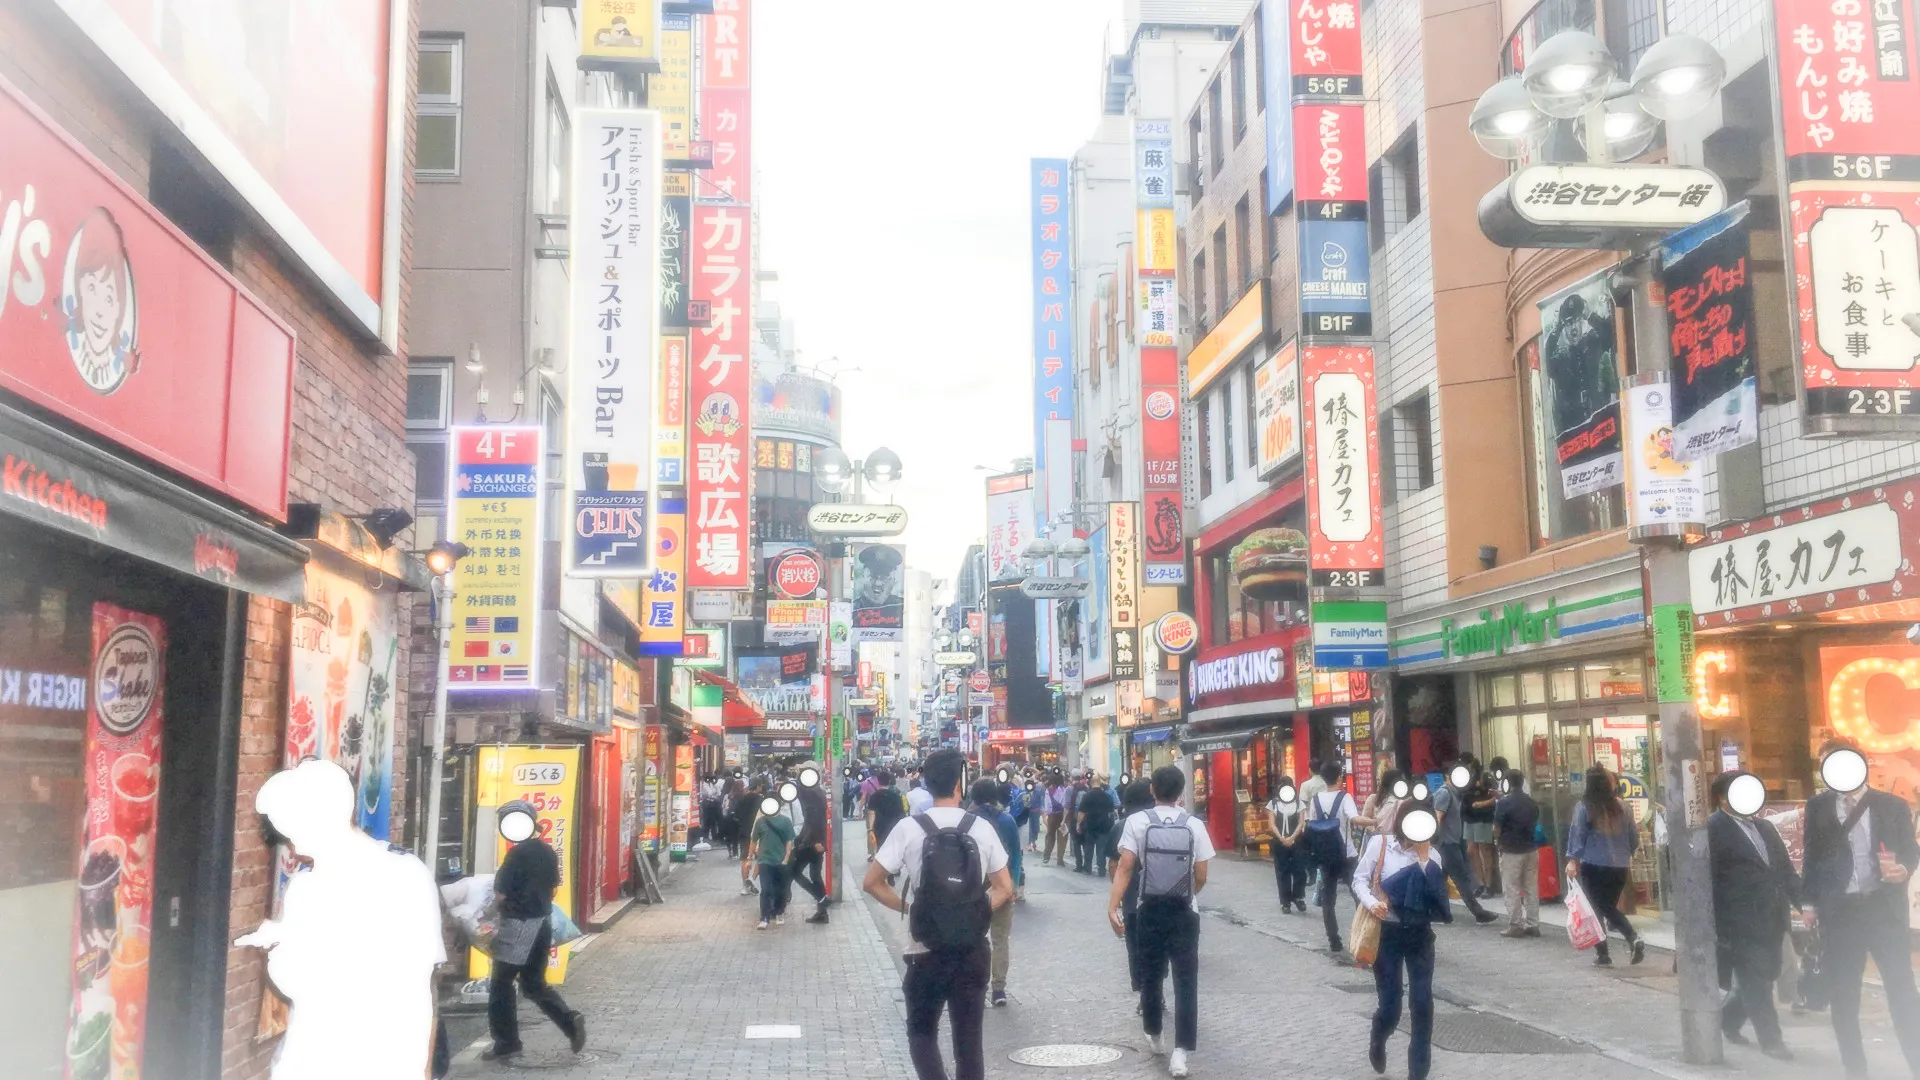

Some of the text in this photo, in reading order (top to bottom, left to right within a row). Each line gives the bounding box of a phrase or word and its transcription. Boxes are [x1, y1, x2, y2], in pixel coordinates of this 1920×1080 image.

[600, 1, 636, 14] 渋谷店
[1793, 23, 1835, 148] もんじゃ
[691, 145, 709, 156] 4F
[1144, 149, 1164, 195] 麻雀
[625, 127, 642, 247] Irish & Sport Bar
[1525, 181, 1713, 208] 渋谷センター街
[1320, 204, 1344, 219] 4F
[1322, 267, 1348, 281] Craft
[1870, 219, 1897, 327] ケーキと
[1302, 282, 1367, 295] CHEESE MARKET
[699, 208, 743, 387] カラオケ
[1320, 315, 1353, 331] B1F
[1841, 271, 1870, 359] お食事
[1145, 333, 1174, 345] 190円
[475, 431, 517, 459] 4F
[1322, 391, 1359, 522] 椿屋カフェ
[473, 473, 537, 484] SAKURA
[1147, 473, 1178, 485] 105席
[3, 453, 107, 530] Kitchen
[473, 483, 527, 493] EXCHANGE
[1640, 487, 1668, 496] Welcome
[695, 443, 742, 577] 歌広場
[814, 512, 902, 525] 渋谷センター街
[576, 507, 643, 539] CELTS
[781, 567, 816, 584] 消火栓
[1147, 568, 1184, 579] センタービル
[1710, 529, 1868, 606] 椿屋カフェ
[648, 568, 678, 627] 松屋
[1161, 620, 1191, 635] BURGER
[1163, 627, 1193, 645] KING
[1330, 628, 1384, 640] FamilyMart
[1440, 596, 1562, 661] FamilyMart
[1115, 667, 1134, 675] B1F
[1197, 647, 1285, 694] BURGER KING
[518, 768, 560, 781] りらくる
